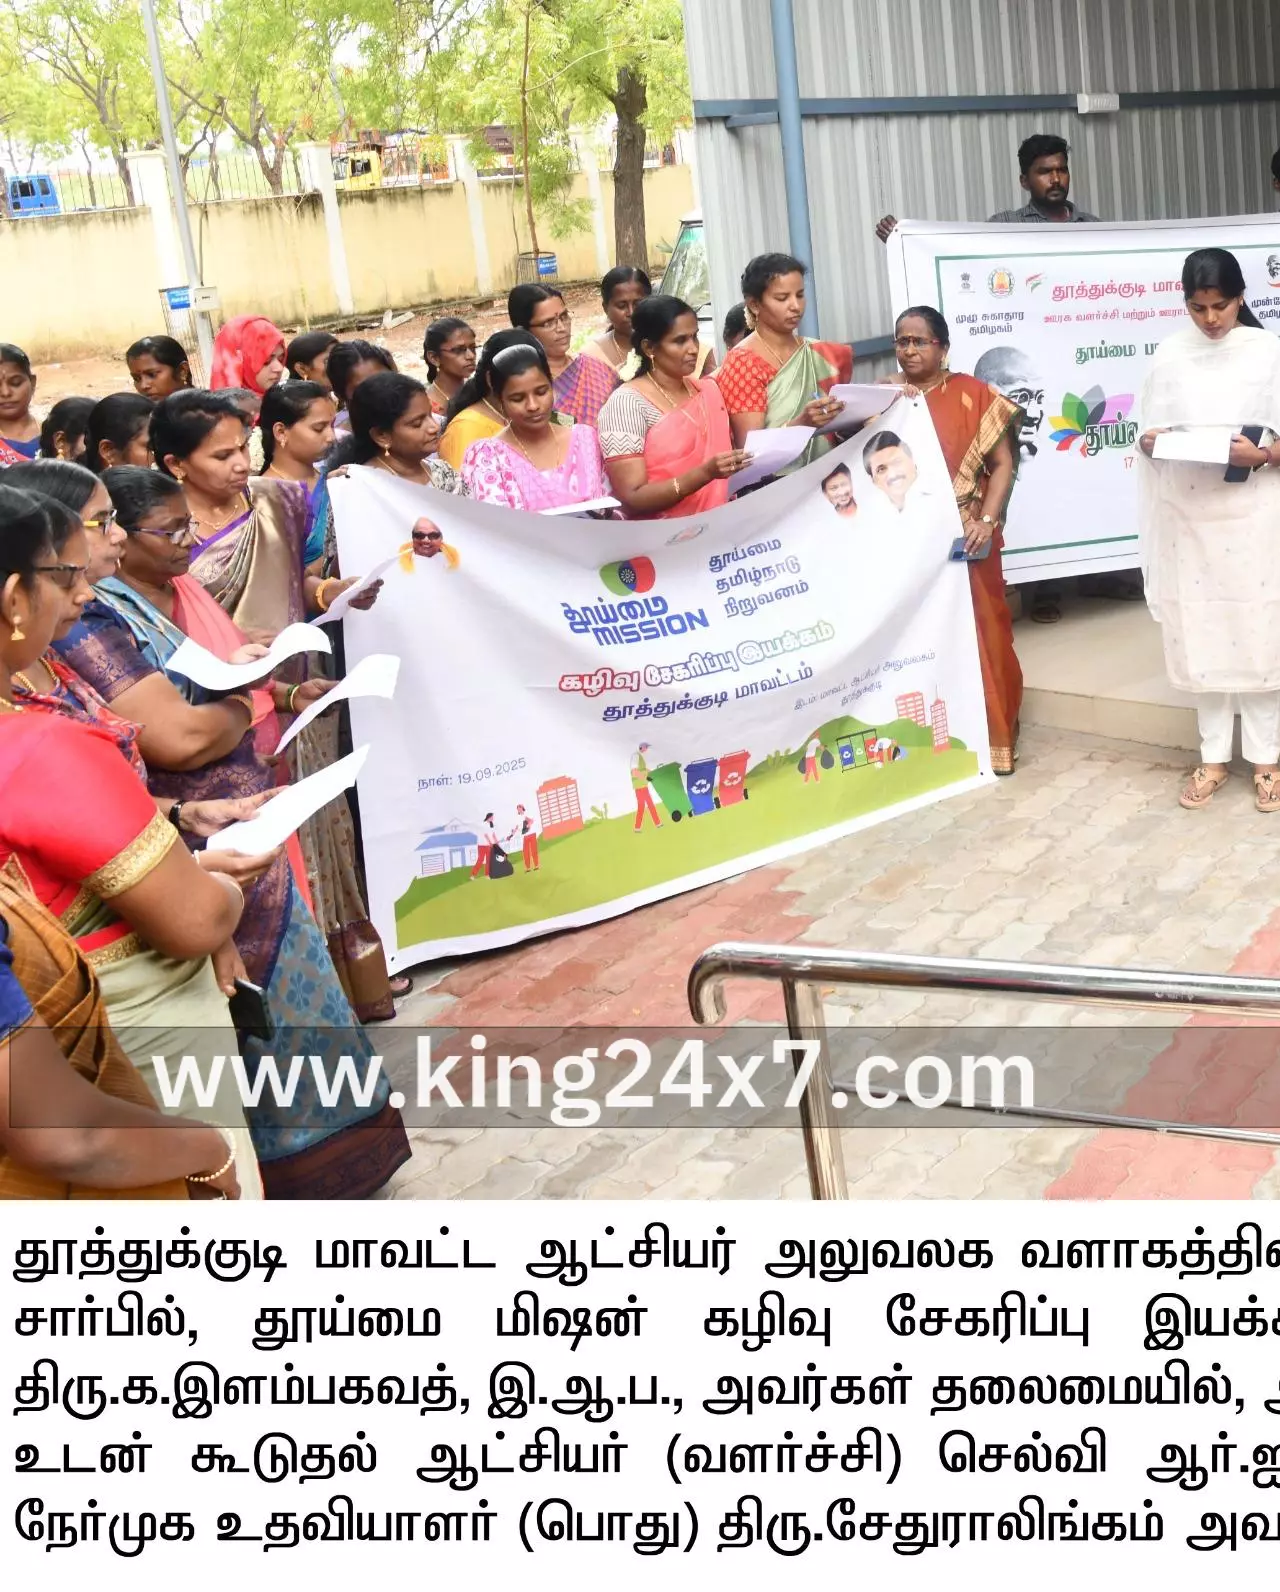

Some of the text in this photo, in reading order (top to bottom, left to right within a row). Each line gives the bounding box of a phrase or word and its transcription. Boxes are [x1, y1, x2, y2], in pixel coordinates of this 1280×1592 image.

[1052, 279, 1147, 302] தூத்துக்குடி
[969, 322, 1013, 336] தமிழகம்
[1122, 308, 1156, 321] மற்றும்
[1076, 339, 1136, 364] தூய்மை
[708, 537, 782, 573] தூய்மை
[715, 554, 801, 595] தமிழ்நாடு
[561, 595, 668, 634] தூய்மை
[724, 579, 809, 618] நிறுவனம்
[558, 619, 836, 698] கழிவு சேகரிப்பு இயக்கம்
[602, 660, 813, 722] தூத்துக்குடி மாவட்டம்
[417, 757, 527, 792] நாள்: 19.09.2025
